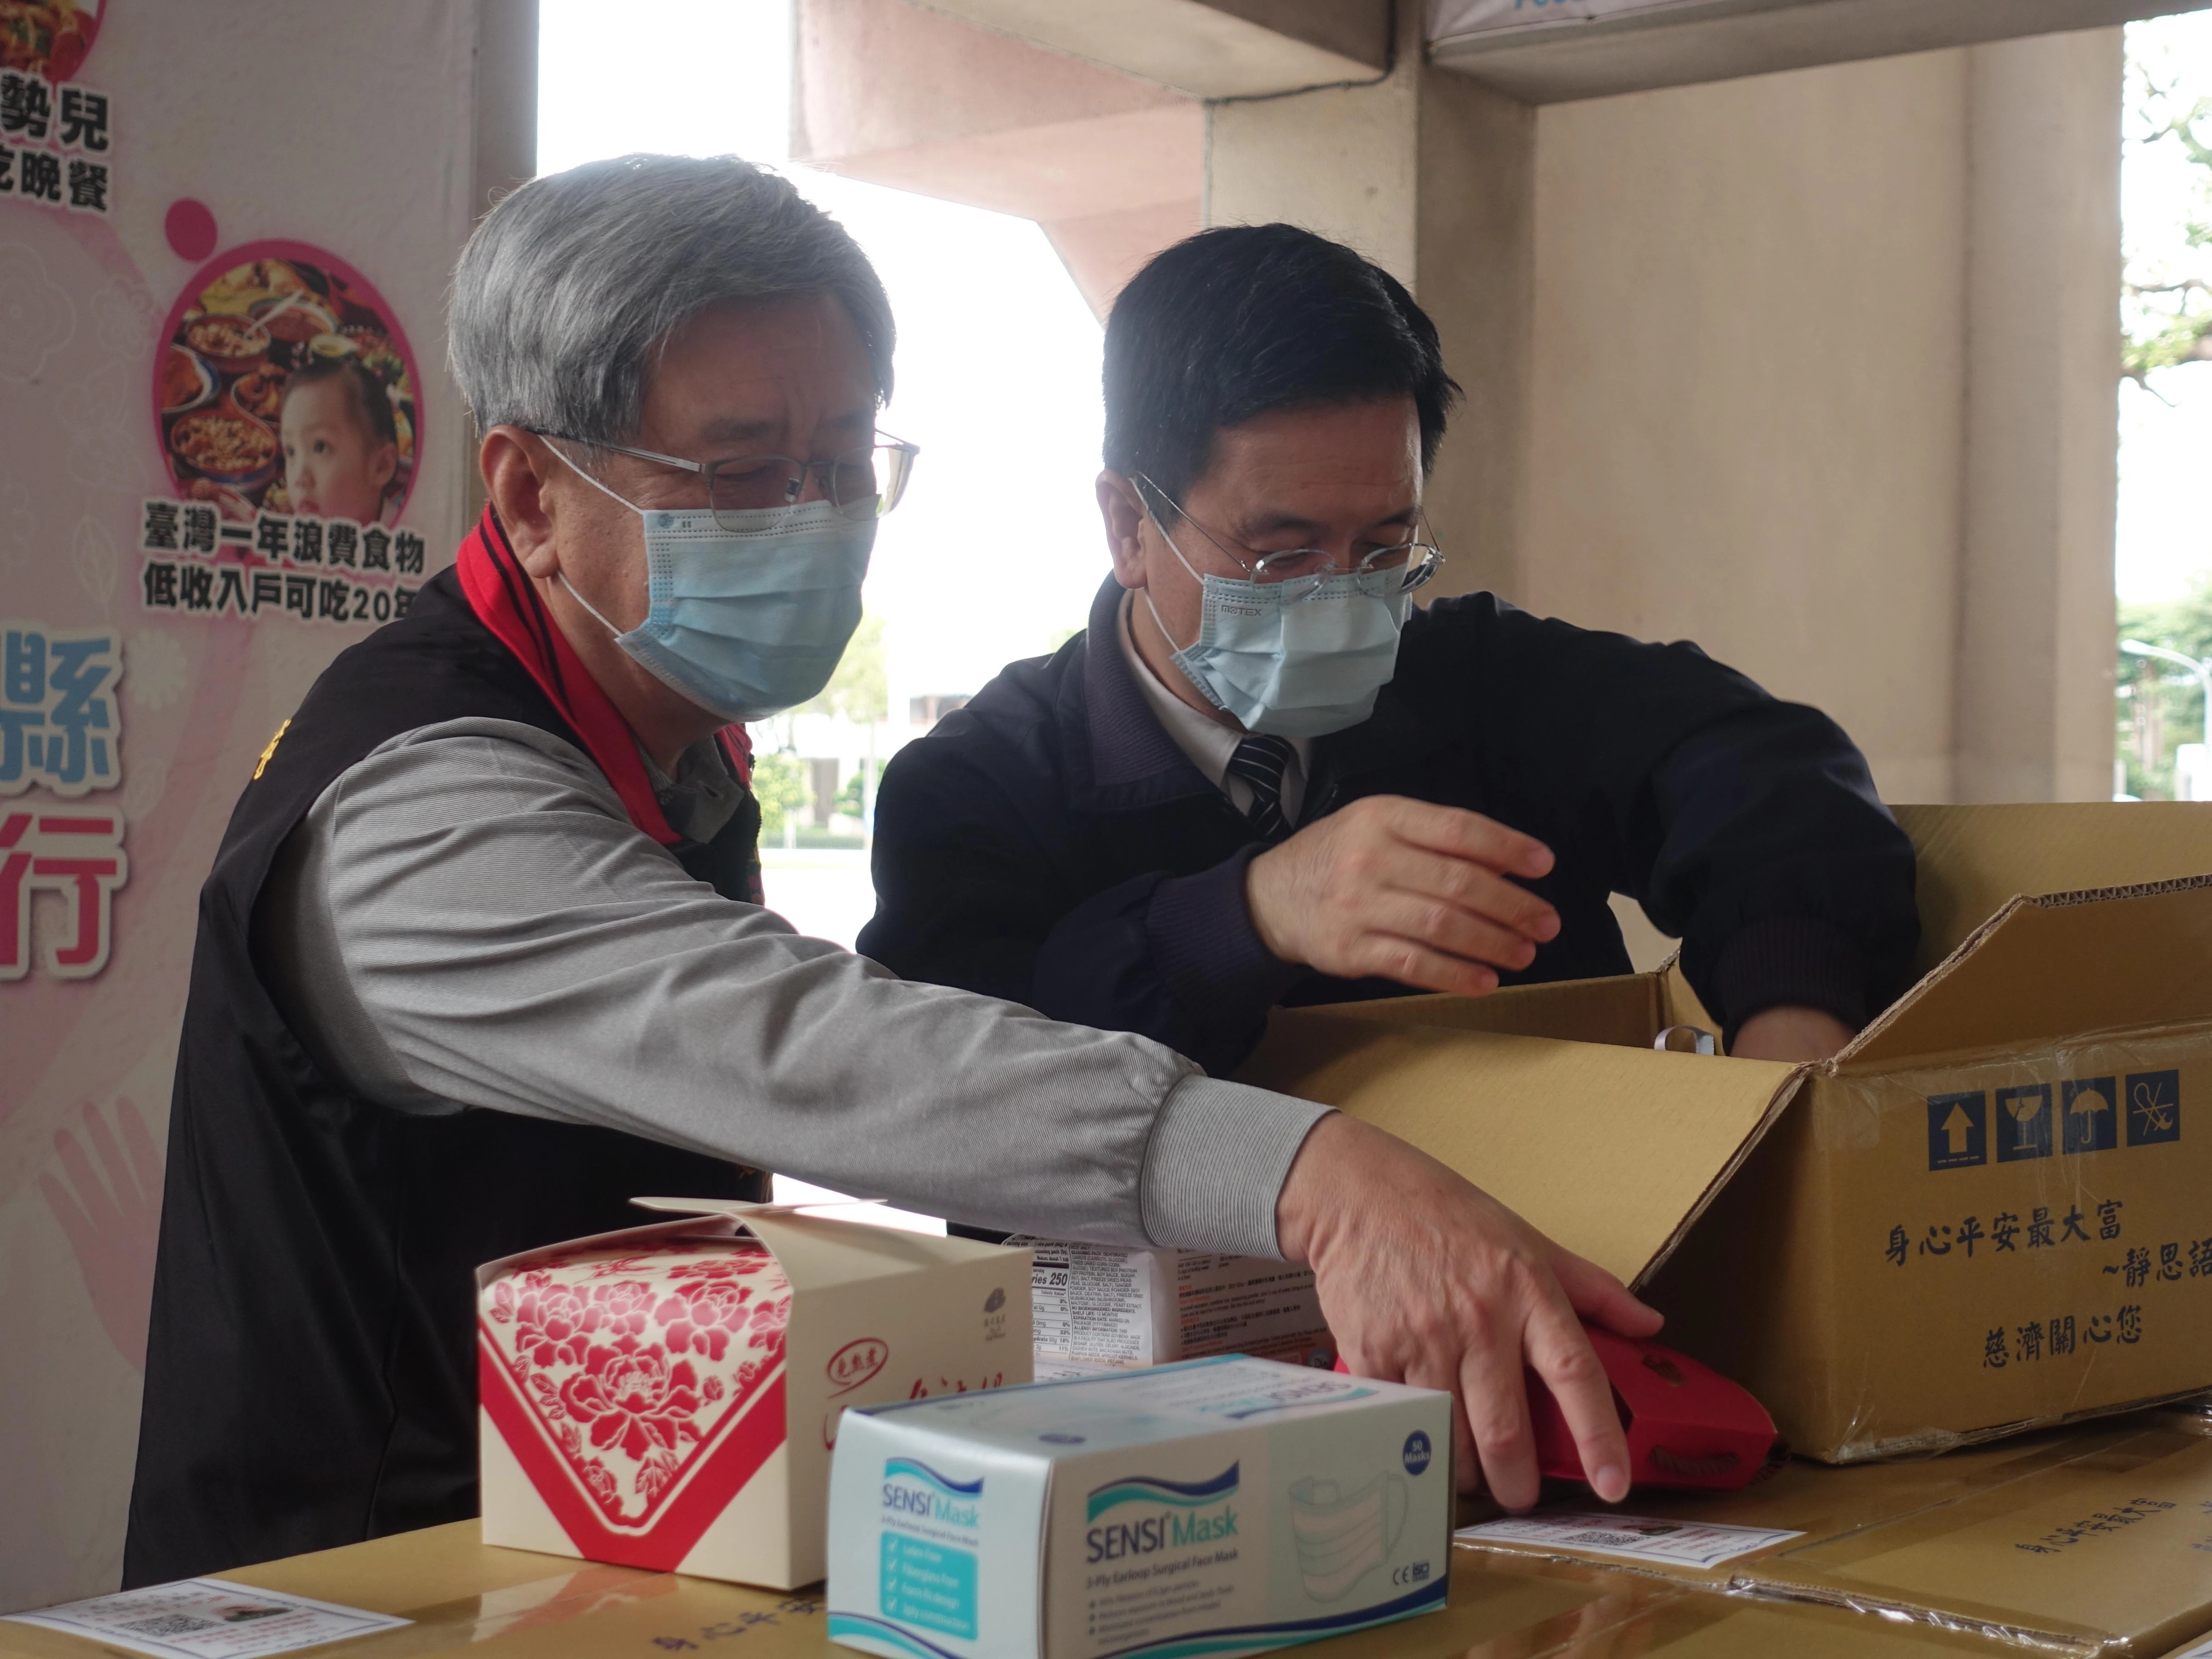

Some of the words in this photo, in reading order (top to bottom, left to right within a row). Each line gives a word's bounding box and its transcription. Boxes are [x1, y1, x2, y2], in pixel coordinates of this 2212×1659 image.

[144, 502, 425, 574] 臺灣一年浪費食物
[1222, 605, 1262, 616] MOTEX
[0, 812, 117, 965] 行
[1885, 1199, 2124, 1267] 身心平安最大富
[1049, 1272, 1068, 1286] 250
[1983, 1304, 2142, 1368] 慈濟關心您
[1404, 1451, 1430, 1464] Masks
[1412, 1439, 1422, 1451] 50
[882, 1483, 931, 1517] SENSI
[935, 1499, 980, 1529] Mask
[1086, 1517, 1165, 1563] SENSI
[1171, 1504, 1238, 1547] Mask
[1086, 1572, 1111, 1589] 3-Ply
[1113, 1568, 1150, 1584] Earloop
[1153, 1558, 1190, 1575] Surgical
[1192, 1555, 1212, 1568] Face
[1215, 1548, 1238, 1563] Mask
